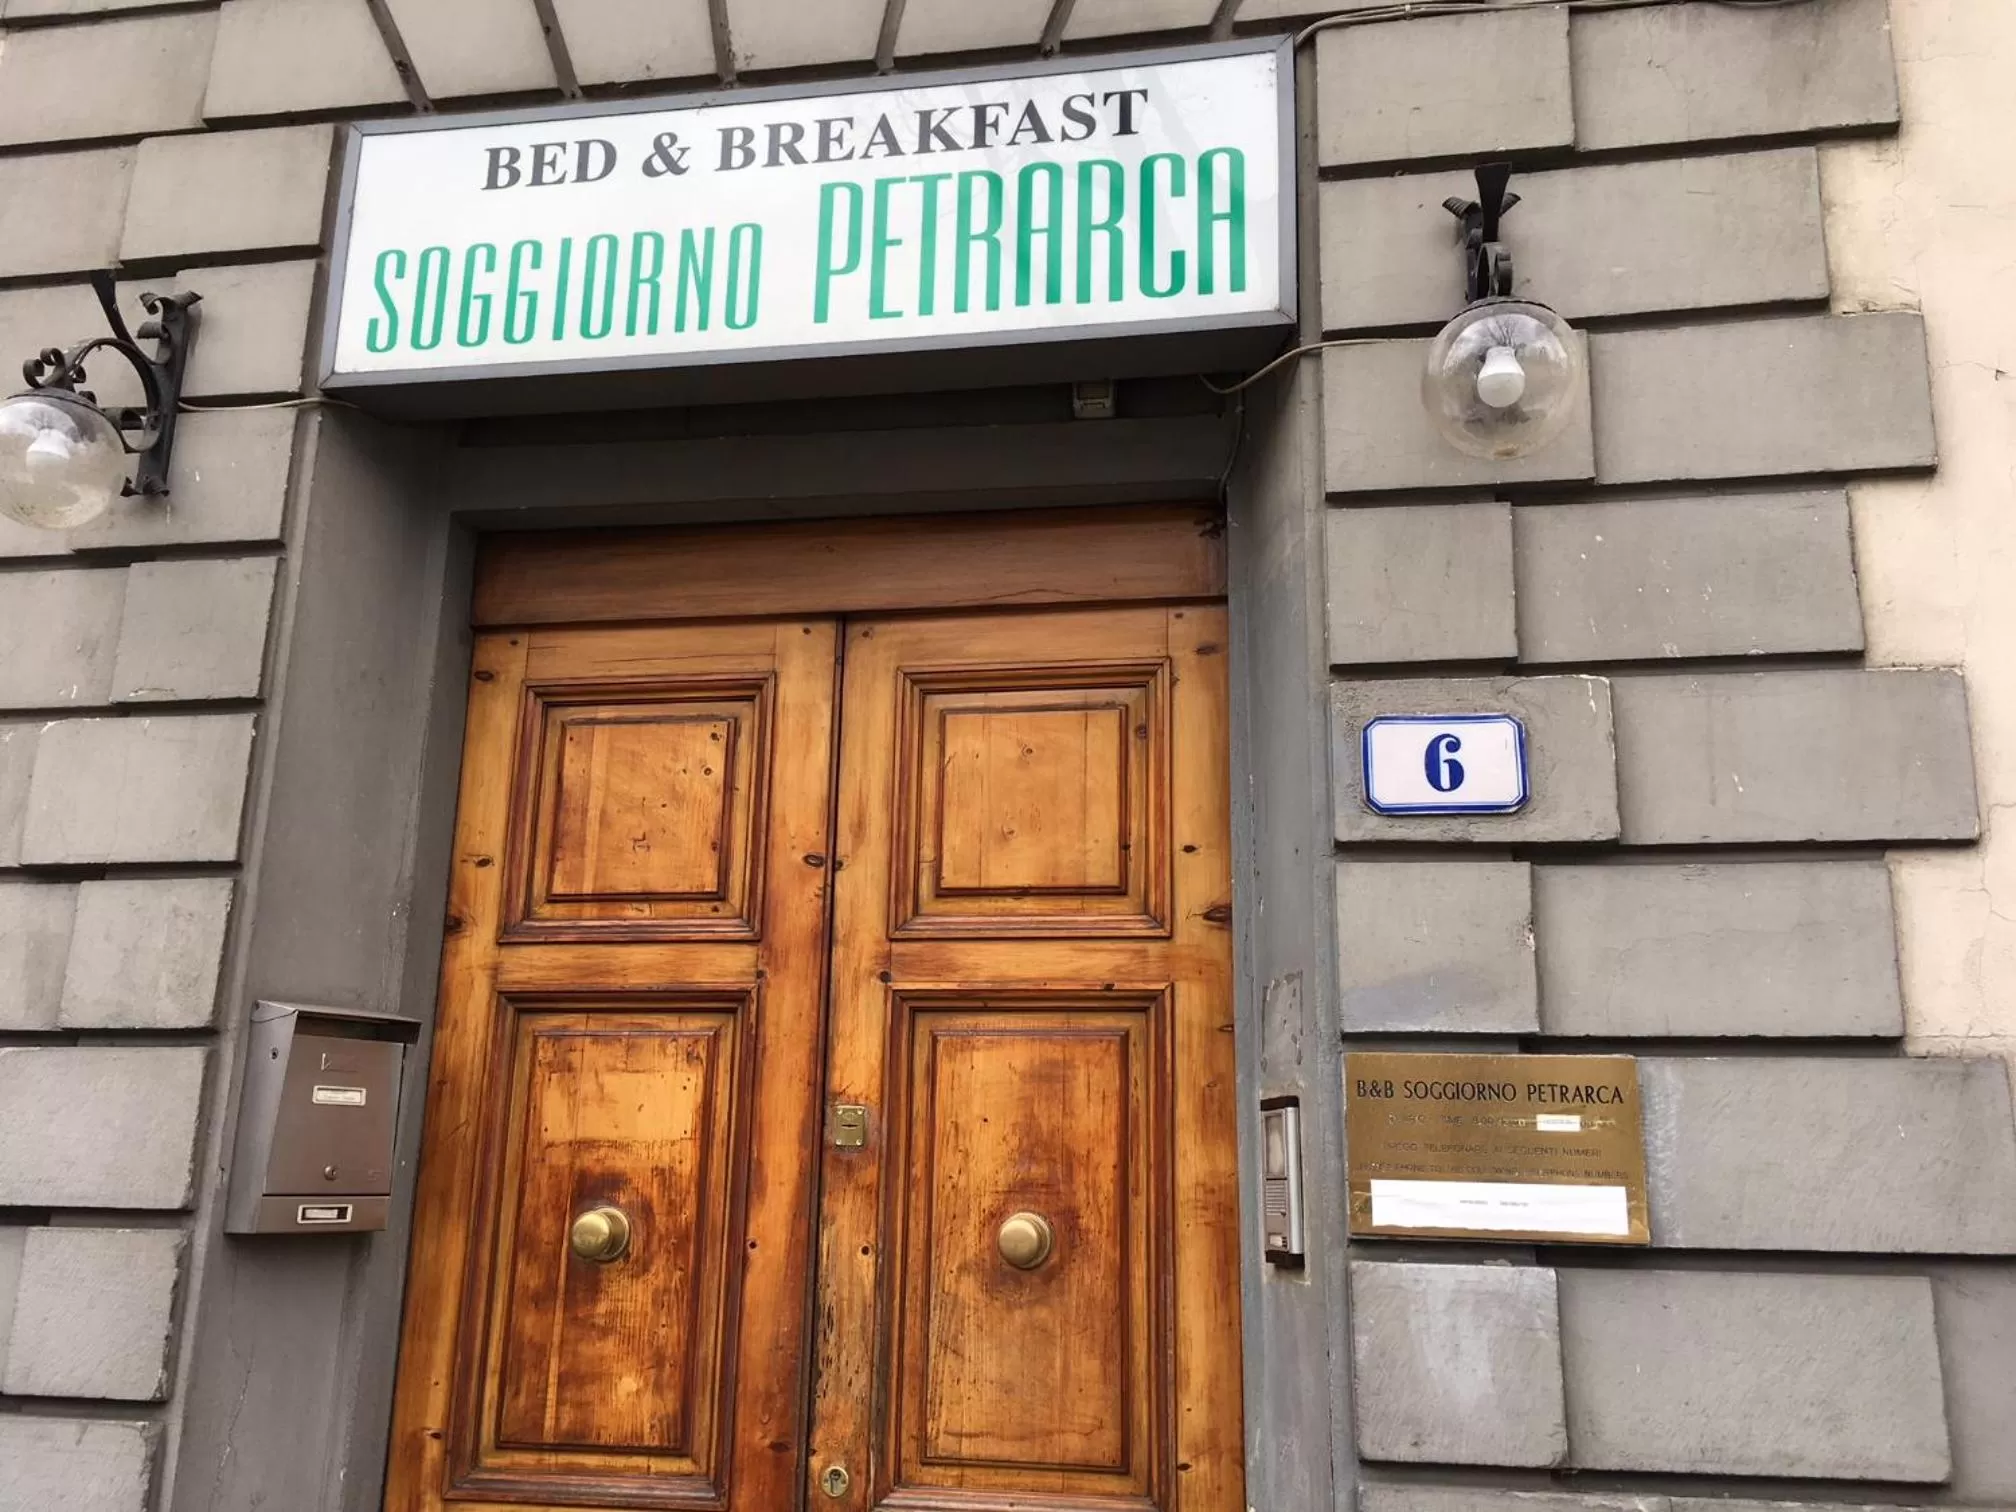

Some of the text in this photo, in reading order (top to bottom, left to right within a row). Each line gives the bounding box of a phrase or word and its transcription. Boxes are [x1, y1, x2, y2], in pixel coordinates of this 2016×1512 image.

[481, 88, 1149, 191] BED & BREAKFAST
[365, 146, 1246, 353] SOGGIORNO PETRARCA
[1424, 733, 1465, 792] 6
[1356, 1079, 1625, 1105] B&B SOGGIORNO PETRARCA
